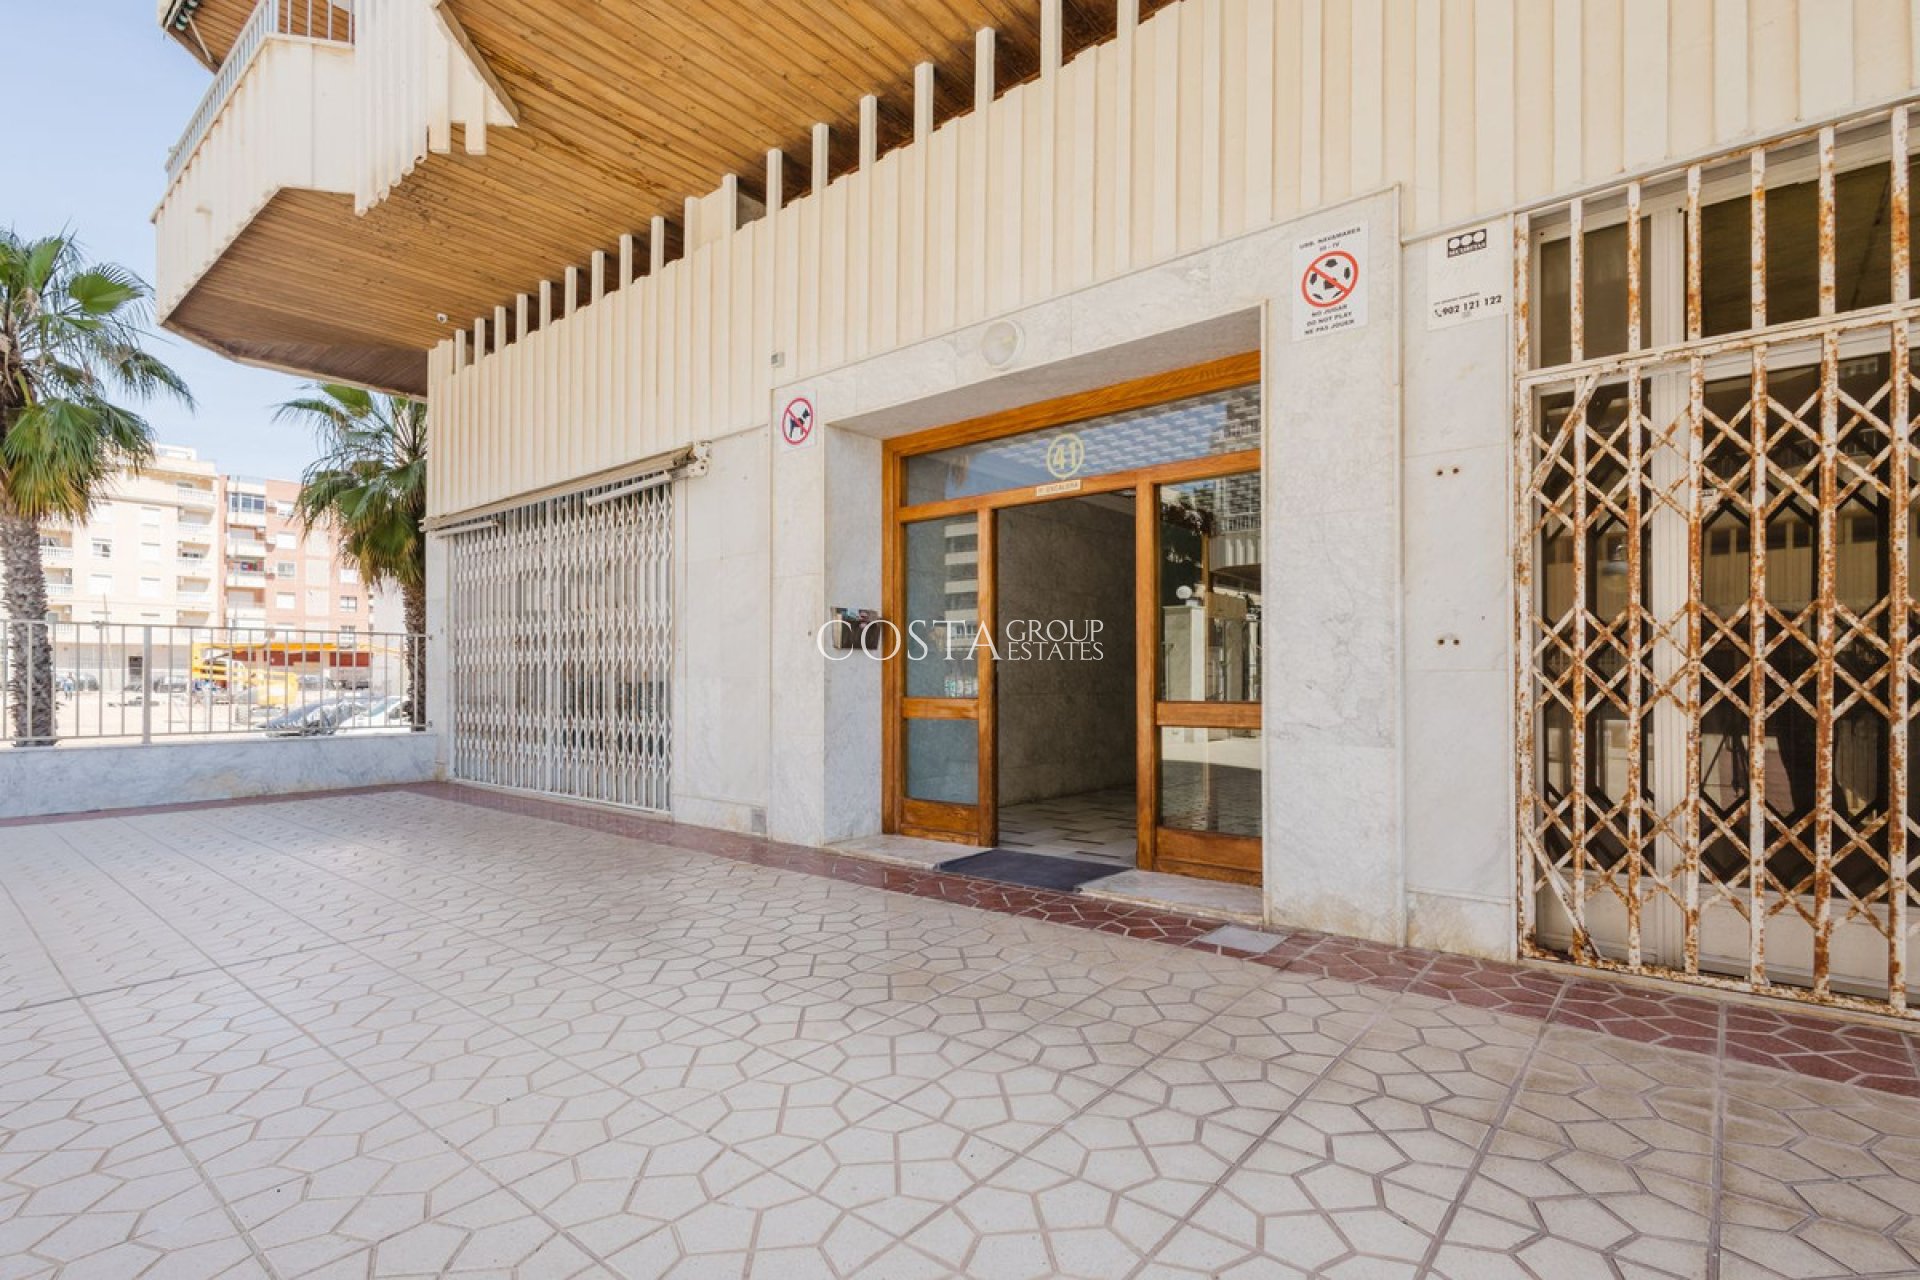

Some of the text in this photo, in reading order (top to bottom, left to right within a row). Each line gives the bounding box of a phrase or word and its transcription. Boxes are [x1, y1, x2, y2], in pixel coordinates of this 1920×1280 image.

[1323, 304, 1348, 315] JUGAR
[1442, 305, 1460, 315] 902
[1463, 300, 1479, 311] 121
[1484, 294, 1502, 306] 122
[1306, 311, 1352, 327] DO NOT PLAY
[1331, 319, 1355, 329] JOUER
[1053, 441, 1077, 470] 41
